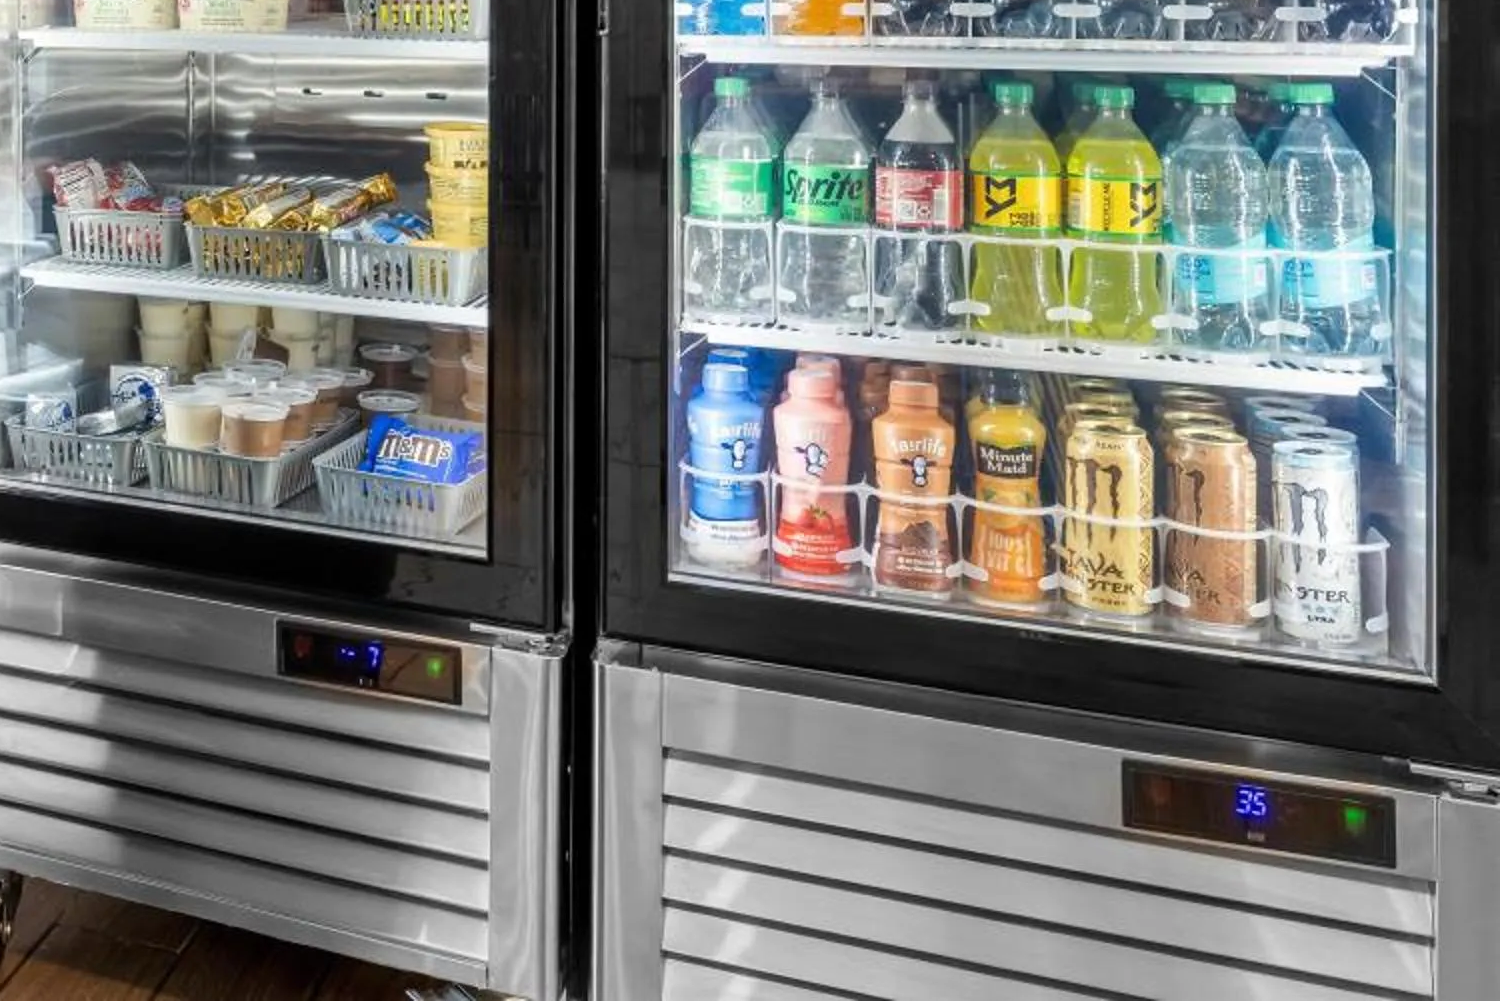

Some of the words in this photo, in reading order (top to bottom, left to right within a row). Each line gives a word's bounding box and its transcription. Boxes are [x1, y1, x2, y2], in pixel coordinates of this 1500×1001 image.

[785, 168, 863, 204] Sprite
[980, 446, 1034, 464] Minute
[986, 460, 1028, 475] Maid
[1235, 788, 1267, 816] 35
